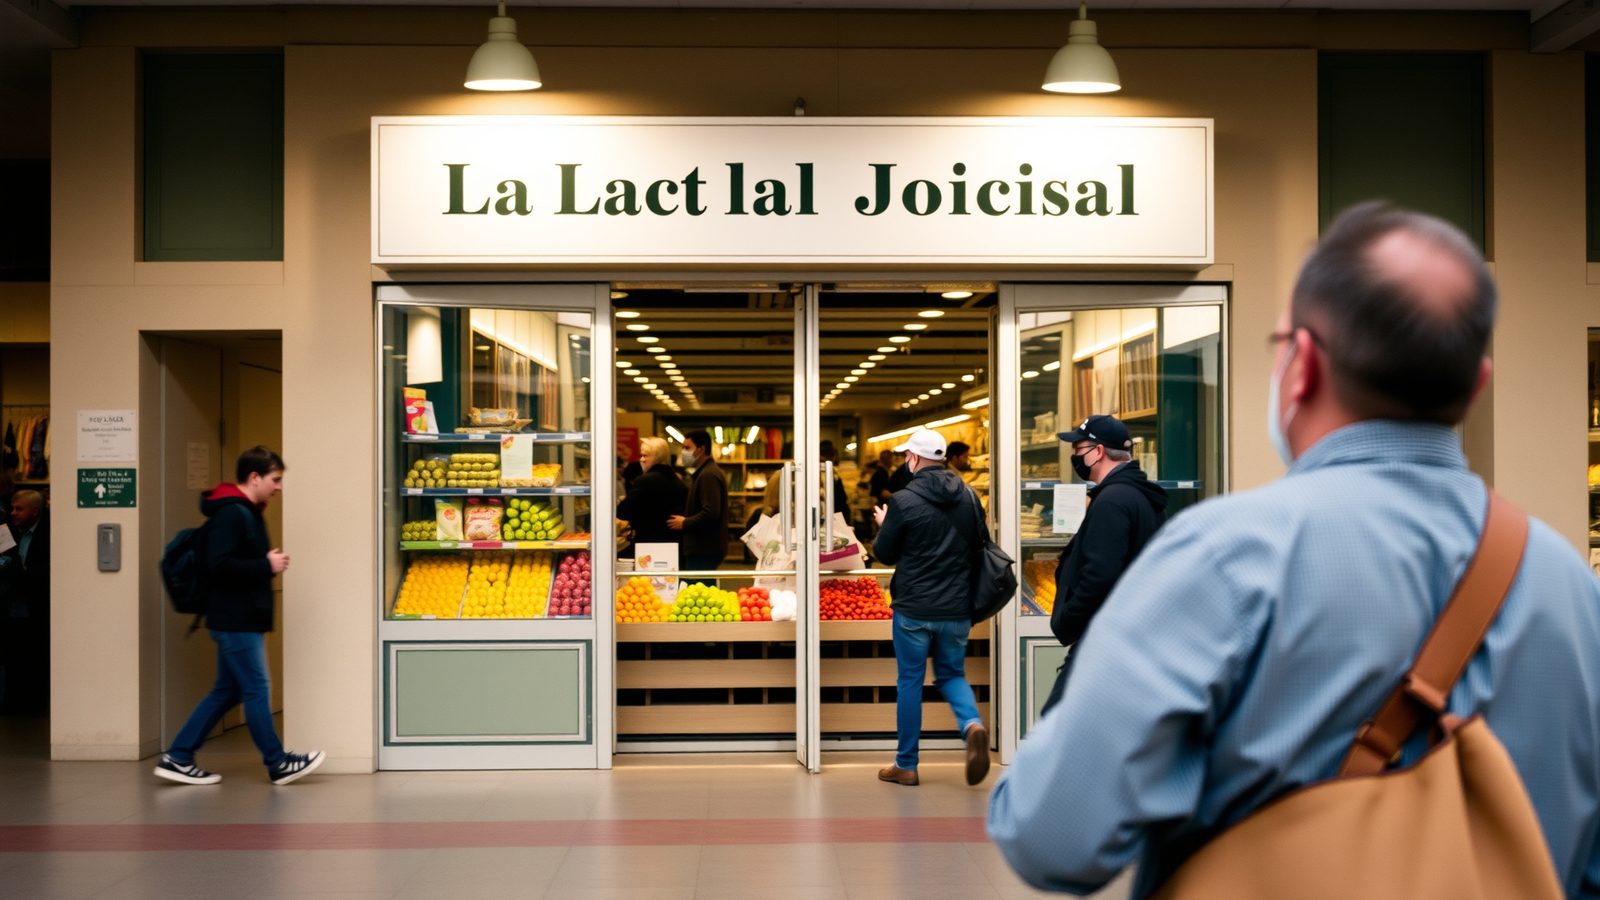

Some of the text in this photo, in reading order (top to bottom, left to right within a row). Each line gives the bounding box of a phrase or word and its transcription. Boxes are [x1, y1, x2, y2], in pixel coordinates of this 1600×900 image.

[443, 163, 532, 216] La
[554, 163, 708, 217] Lact
[854, 162, 1139, 217] Joicisal
